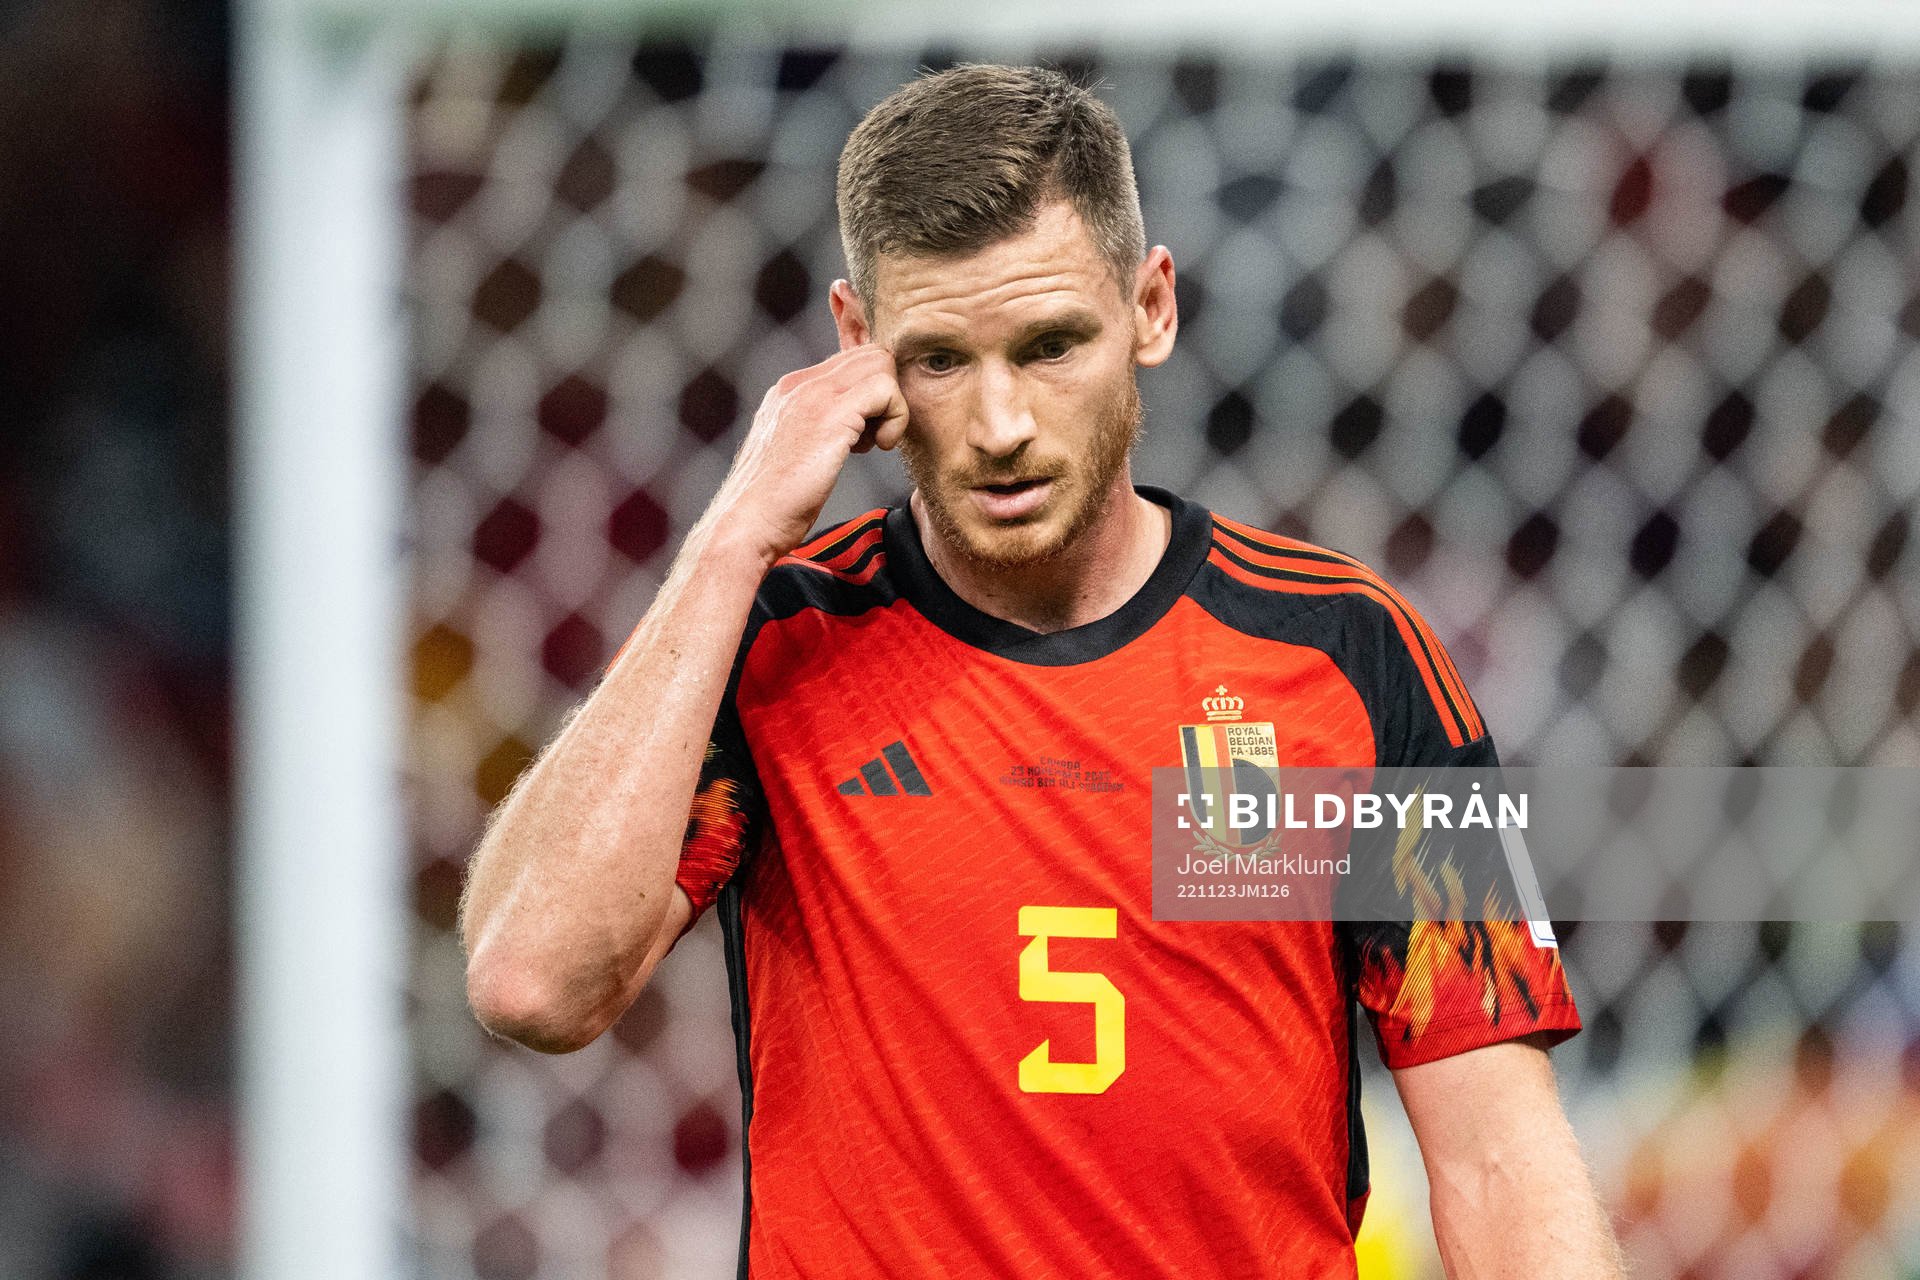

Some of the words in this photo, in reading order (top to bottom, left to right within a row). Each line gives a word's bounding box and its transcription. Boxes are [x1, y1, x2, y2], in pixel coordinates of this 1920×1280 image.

[1227, 726, 1261, 736] ROYAL
[1229, 736, 1273, 746] BELGIAN
[1018, 905, 1126, 1095] 5
